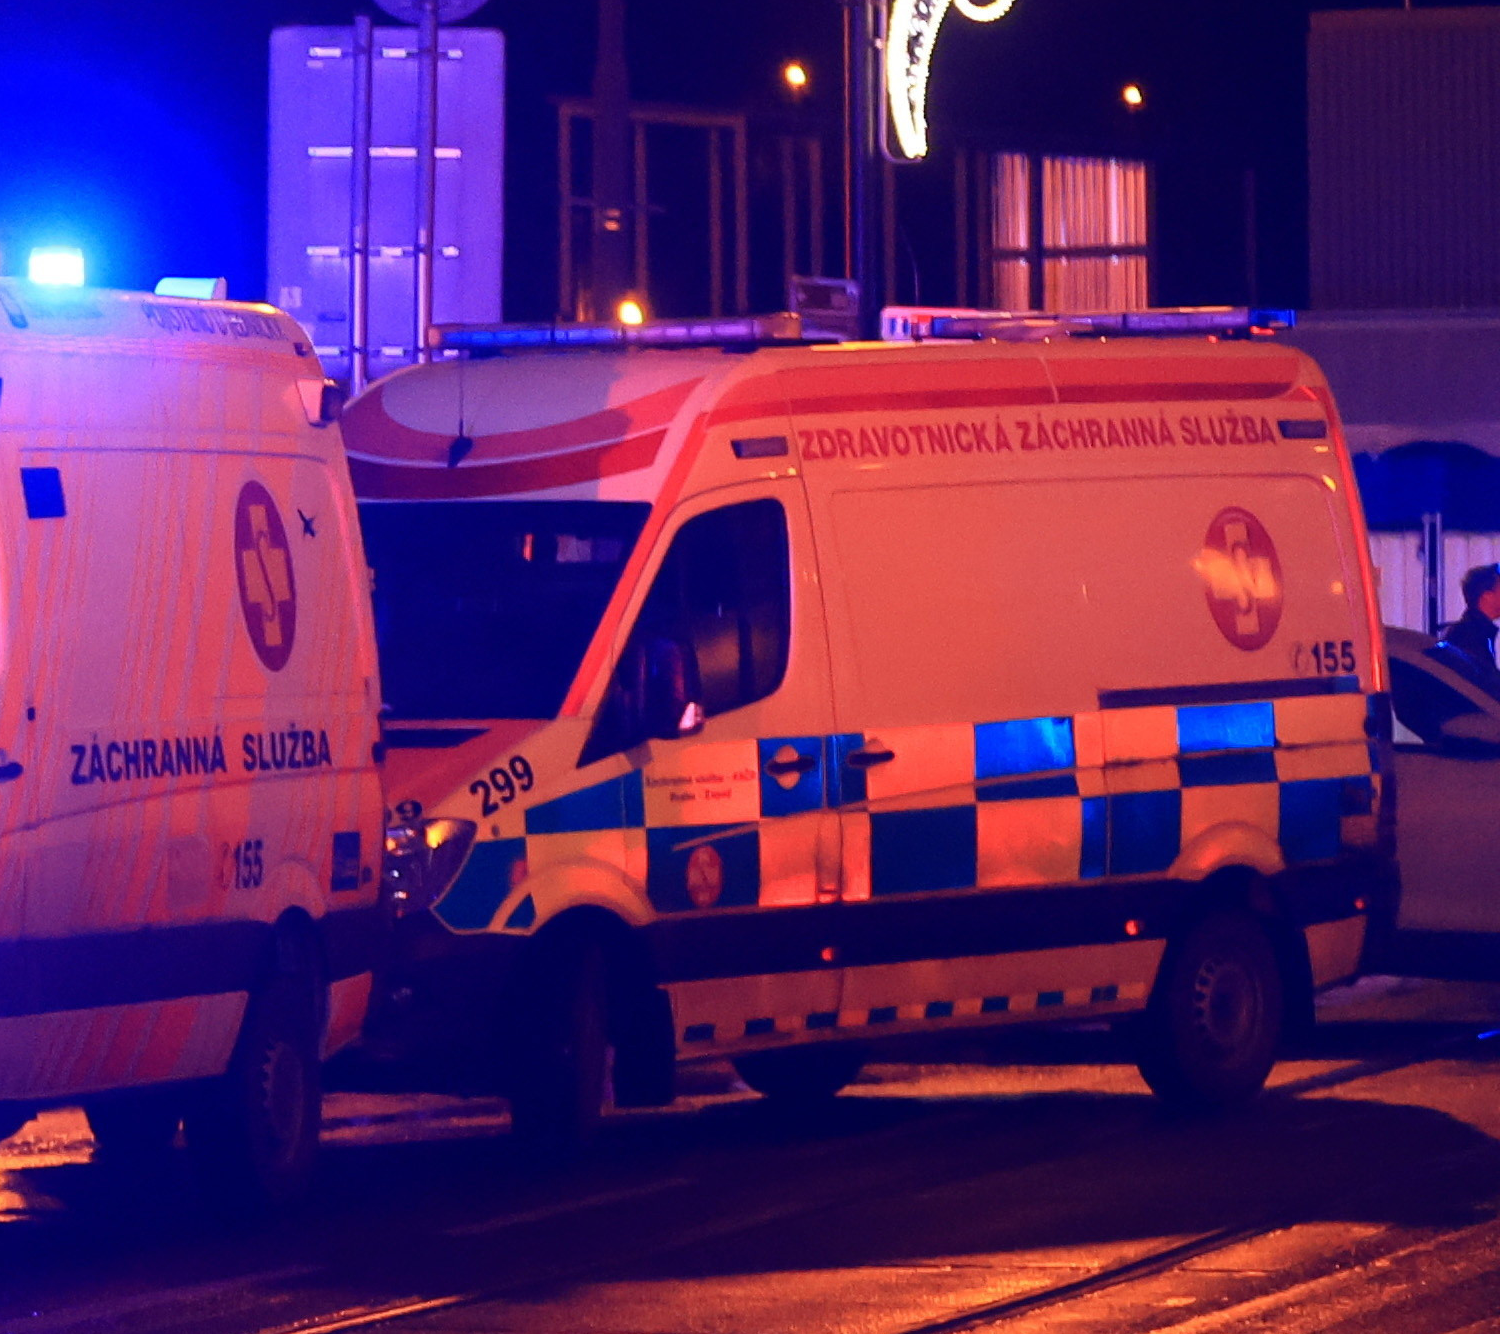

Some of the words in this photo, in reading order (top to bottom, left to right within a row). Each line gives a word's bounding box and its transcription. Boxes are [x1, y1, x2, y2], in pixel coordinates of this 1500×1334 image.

[798, 414, 1013, 461] ZDRAVOTNICKÁ
[1015, 409, 1176, 451] ZÁCHRANNÁ
[1180, 408, 1277, 446] SLUŽBA
[1311, 640, 1357, 674] 155
[69, 731, 228, 786] ZÁCHRANNÁ
[241, 721, 333, 772] SLUŽBA
[468, 754, 535, 817] 299
[235, 838, 263, 890] 155
